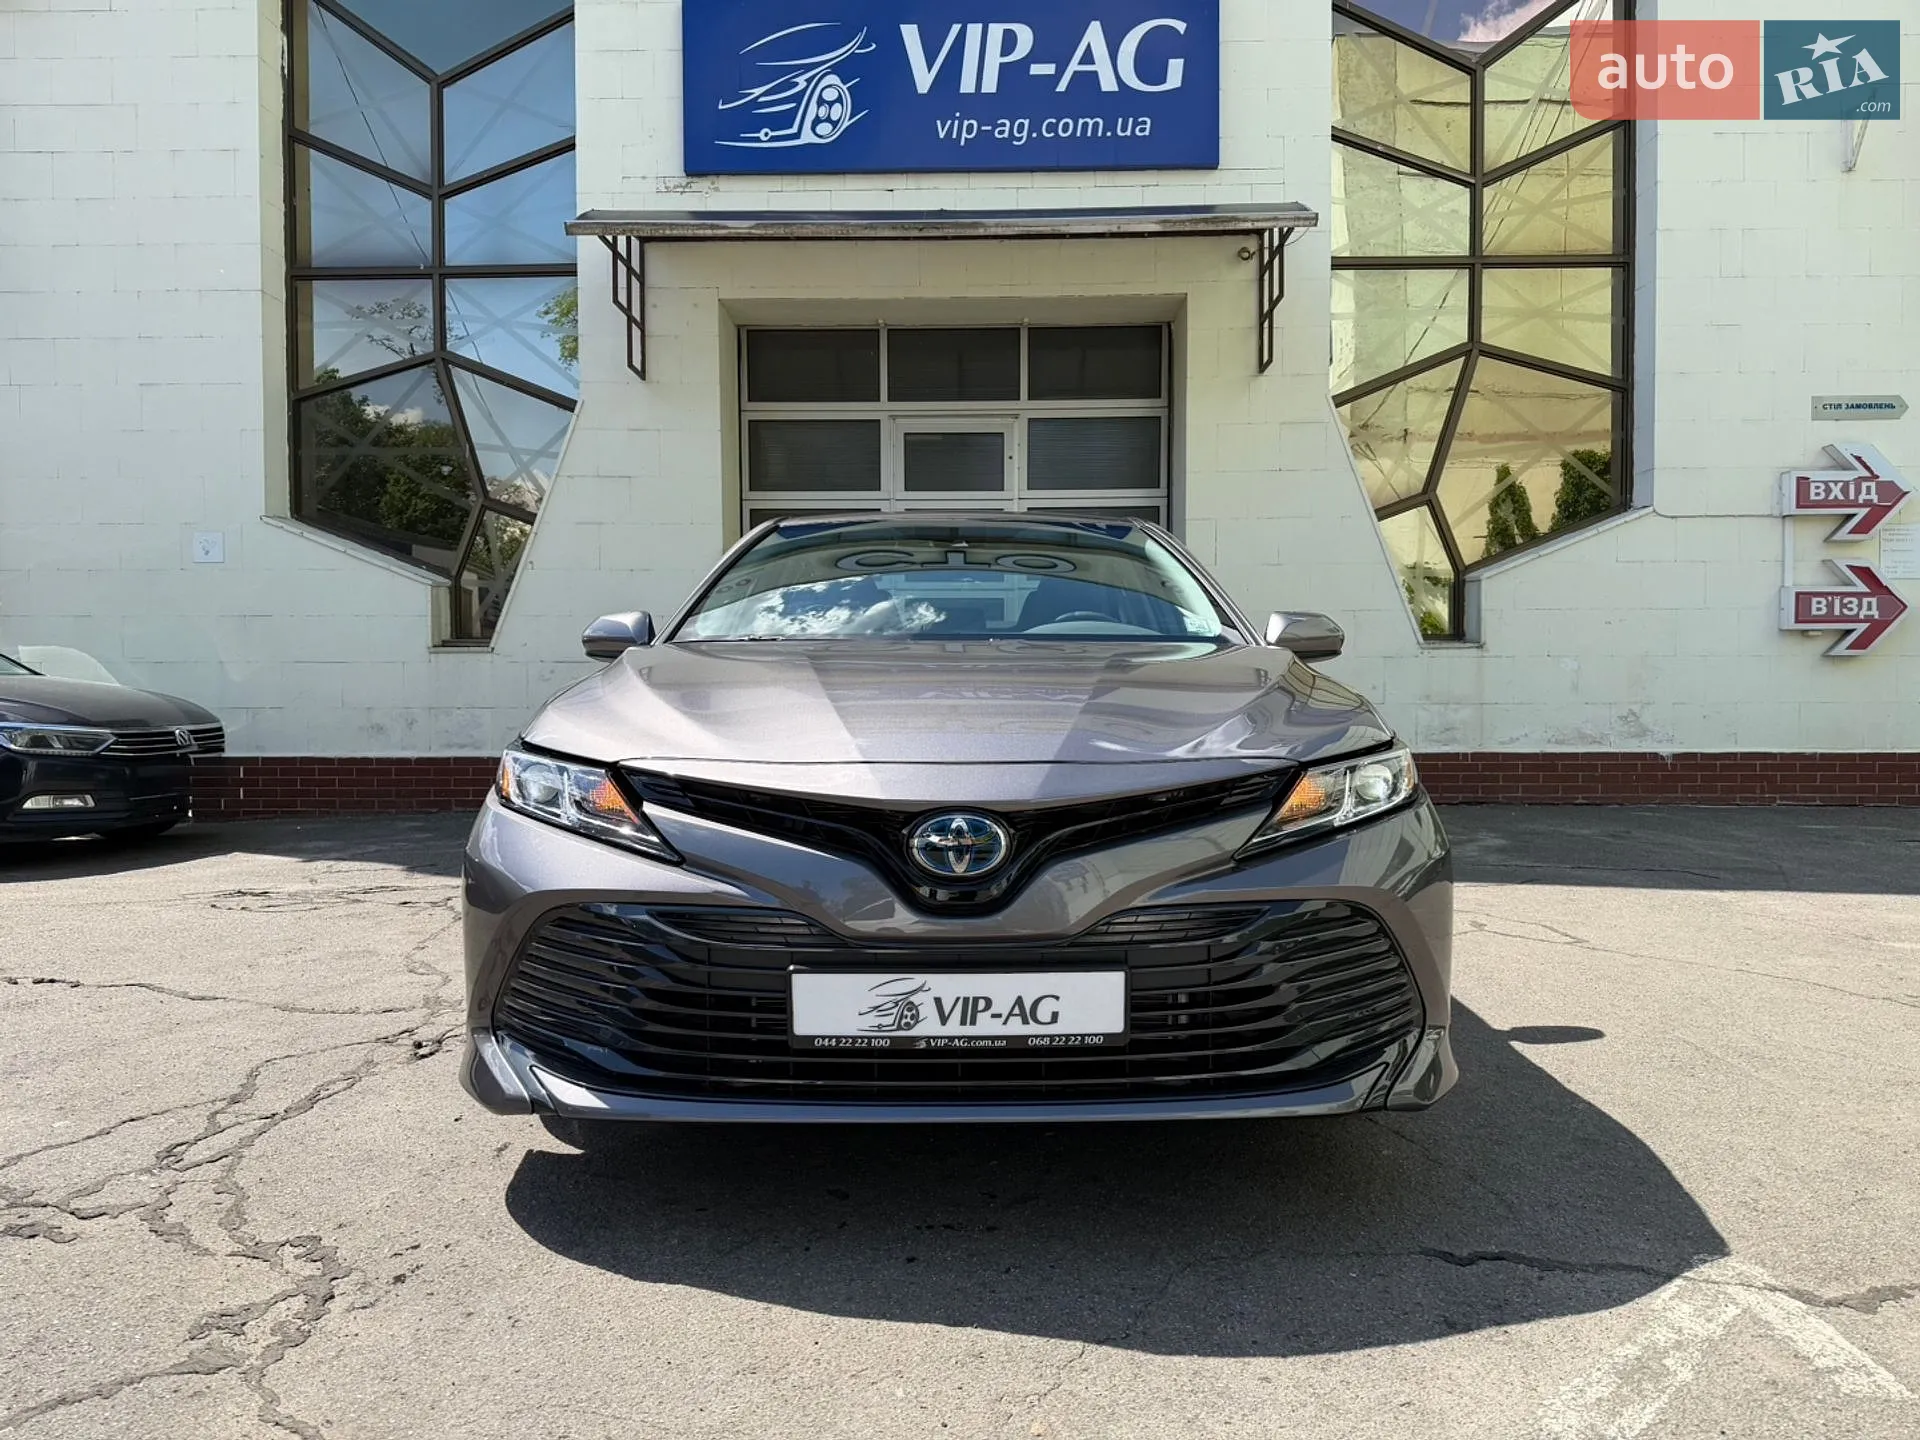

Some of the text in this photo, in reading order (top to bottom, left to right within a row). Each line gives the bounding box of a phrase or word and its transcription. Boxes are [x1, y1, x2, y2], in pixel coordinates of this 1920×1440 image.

[900, 18, 1188, 94] VIP-AG
[935, 112, 1152, 146] vip-ag.com.ua
[1809, 481, 1878, 503] ВХІД
[933, 994, 1060, 1027] VIP-AG
[814, 1037, 891, 1047] 044 22 22 100
[929, 1038, 1007, 1048] VIP-AG.com.ua
[1028, 1035, 1104, 1046] 068 22 22 100
